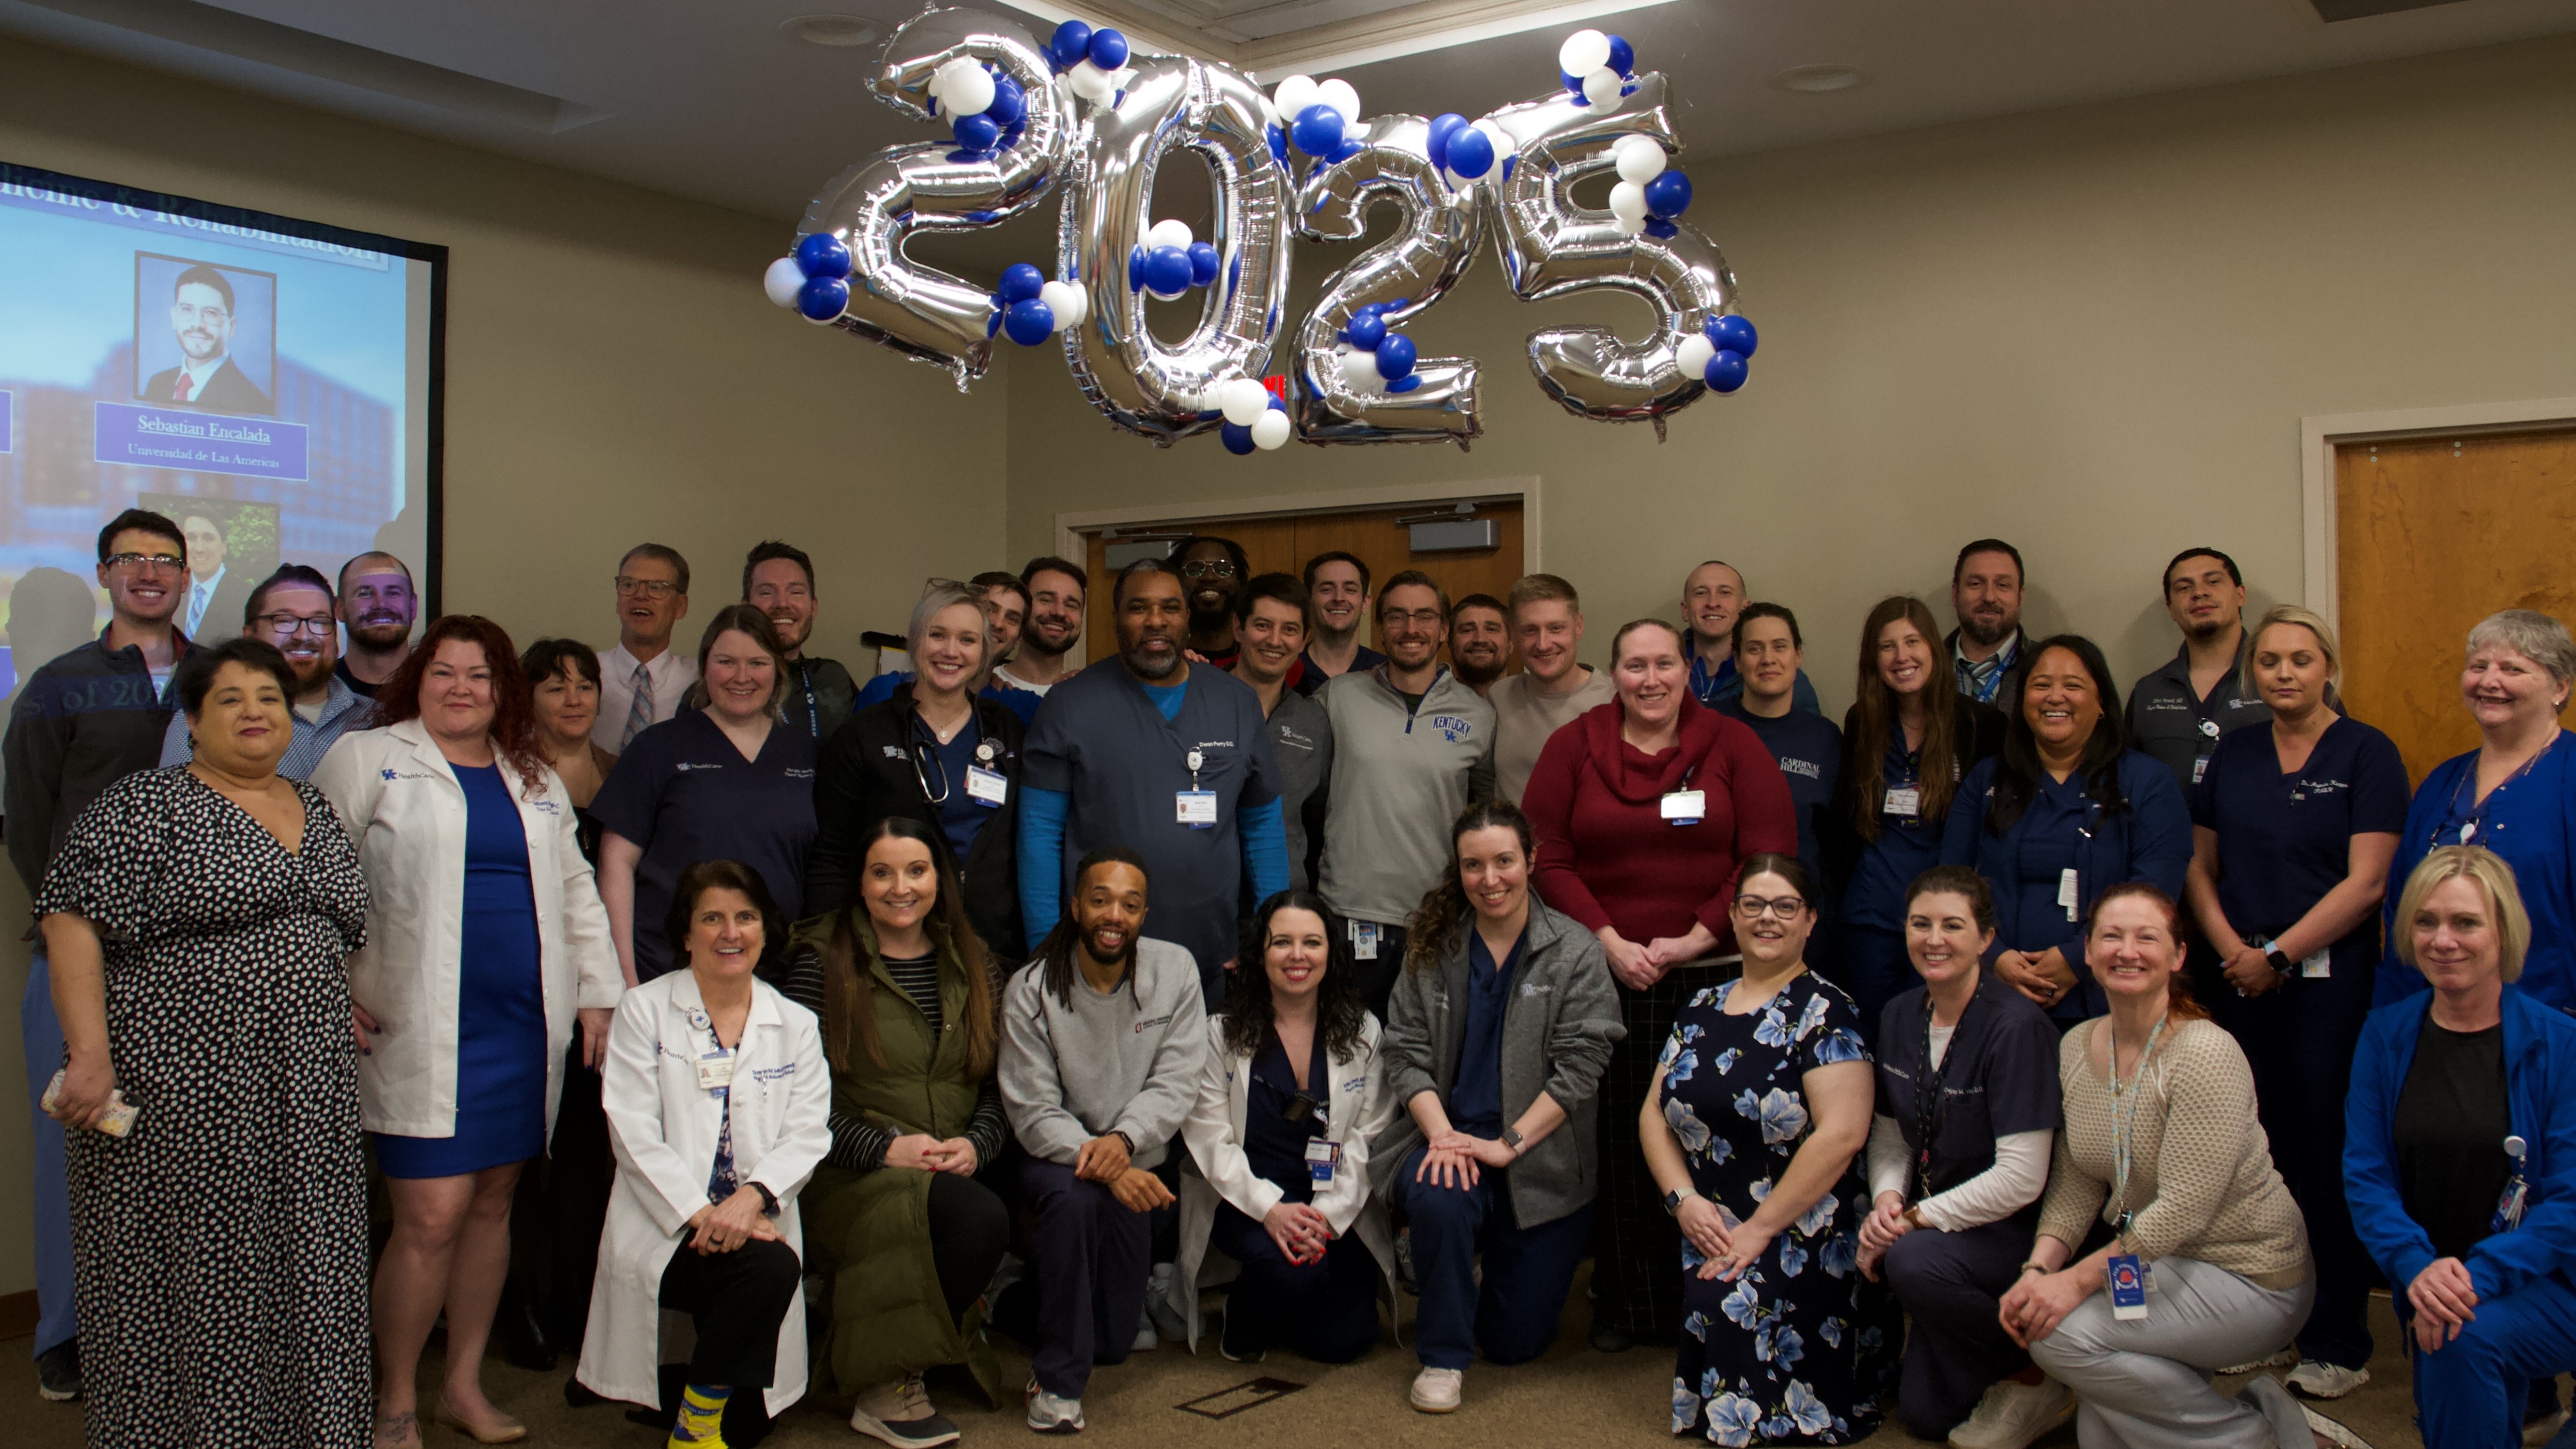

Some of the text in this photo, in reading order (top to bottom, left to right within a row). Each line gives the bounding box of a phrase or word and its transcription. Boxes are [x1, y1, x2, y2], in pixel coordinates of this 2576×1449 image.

[797, 3, 1740, 447] 2025
[138, 415, 271, 443] Sebastian Encalada
[128, 443, 280, 468] Universidad de Las Americas
[62, 680, 99, 710] of
[1433, 715, 1472, 738] KENTUCKY
[1781, 756, 1820, 773] CARDINAL
[1781, 762, 1799, 773] HILL
